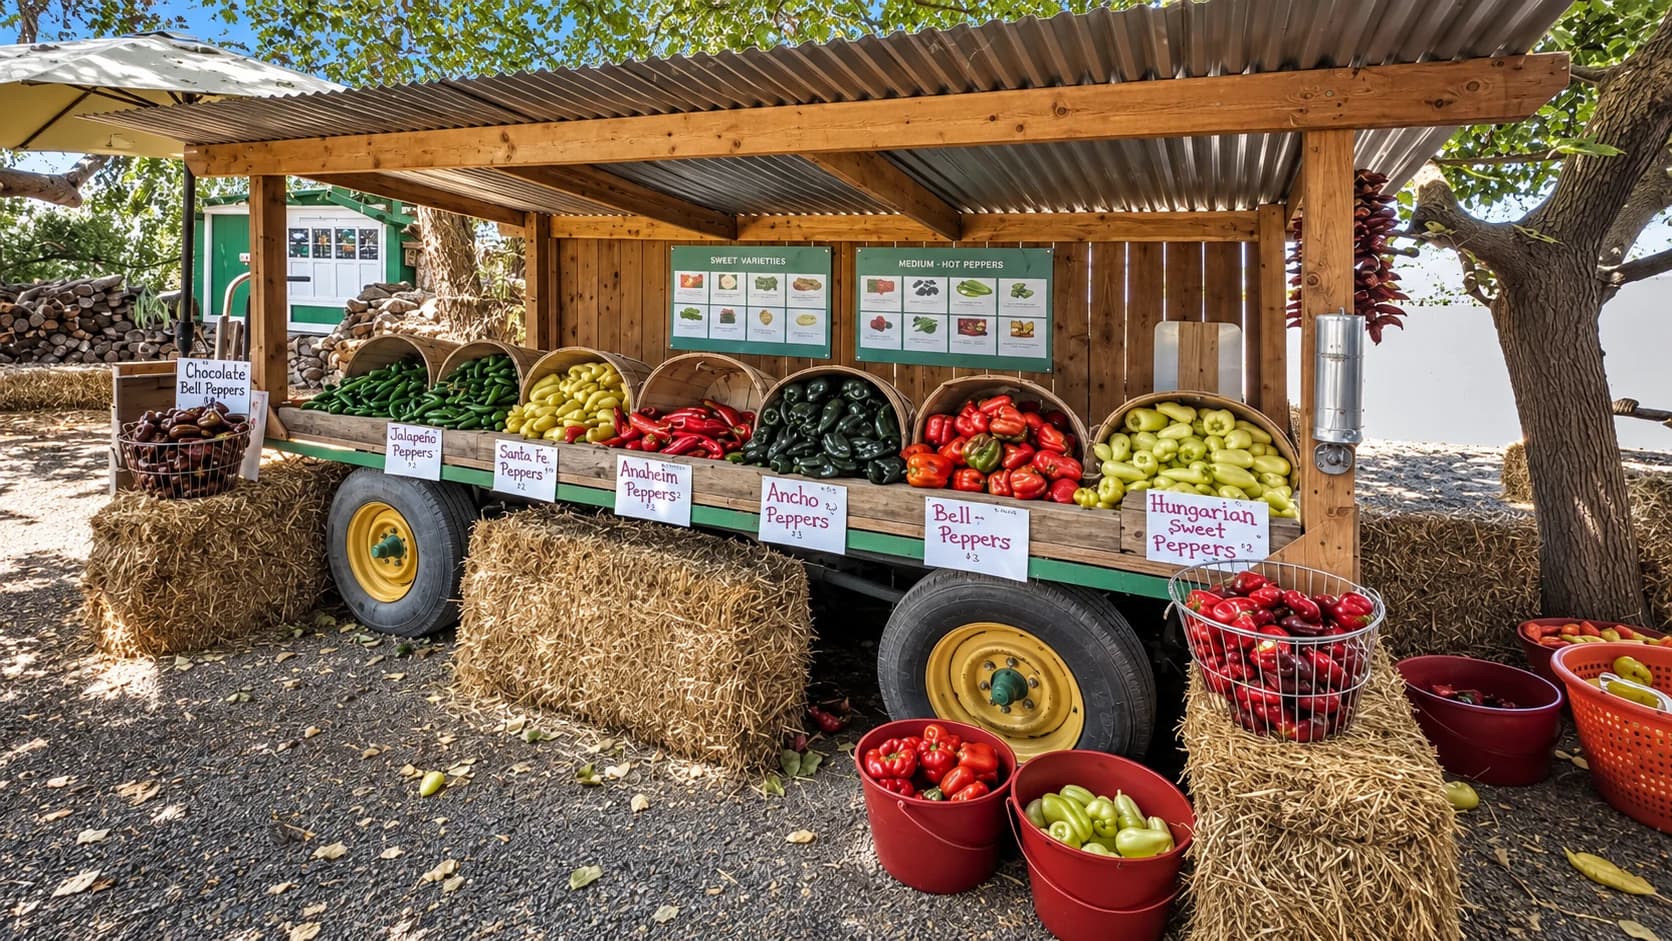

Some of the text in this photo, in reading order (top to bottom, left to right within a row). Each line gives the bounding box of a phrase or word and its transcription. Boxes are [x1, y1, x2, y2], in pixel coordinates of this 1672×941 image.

[710, 256, 738, 265] SWEET
[898, 259, 934, 269] MEDIUM
[942, 259, 961, 269] HOT
[963, 260, 1004, 269] PEPPERS
[185, 361, 246, 381] Chocolate
[180, 380, 245, 399] Bell Peppers
[390, 426, 437, 447] Jalapeño
[392, 443, 433, 461] Peppers
[499, 444, 532, 462] Santa
[499, 461, 543, 482] Peppers
[620, 459, 679, 485] Anaheim
[624, 481, 676, 504] Peppers
[766, 481, 819, 508] Ancho
[765, 506, 830, 531] Peppers
[1149, 493, 1258, 526] Hungarian
[937, 525, 1011, 551] Peppers
[1168, 519, 1226, 539] Sweet
[1152, 534, 1237, 559] Peppers
